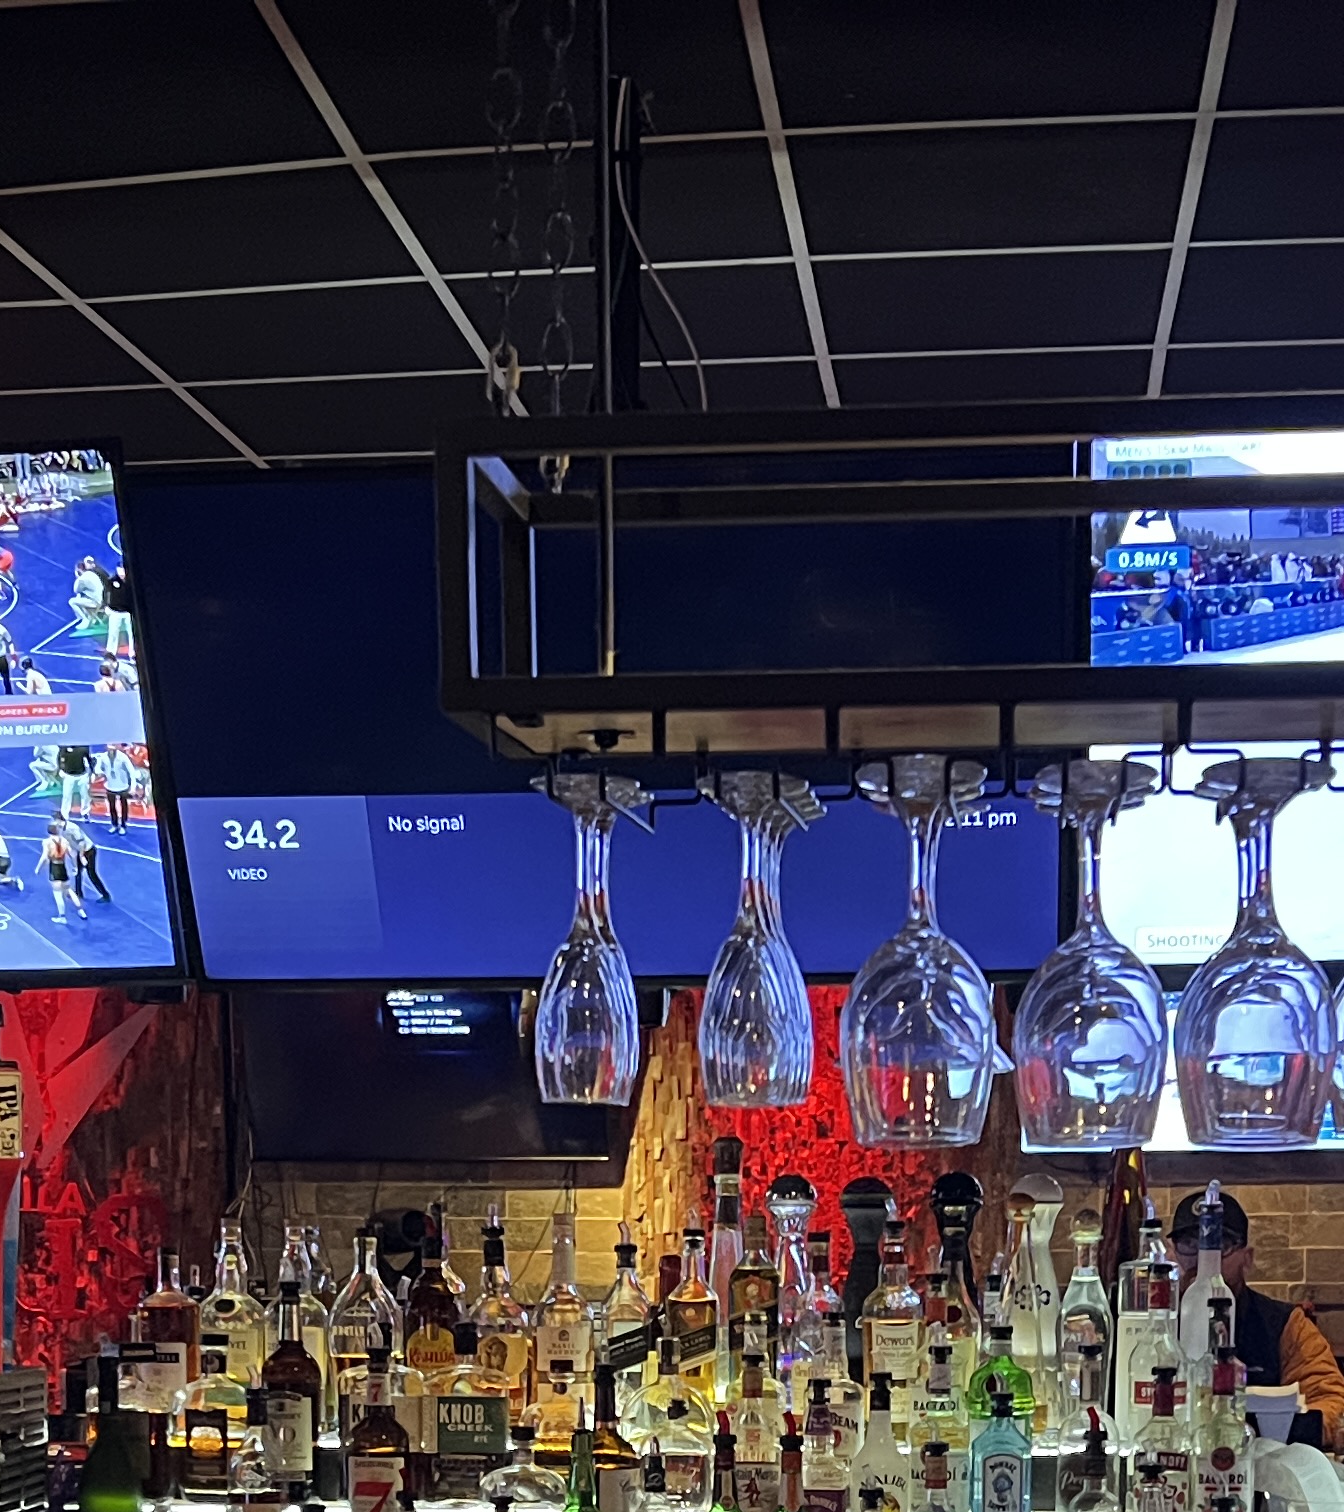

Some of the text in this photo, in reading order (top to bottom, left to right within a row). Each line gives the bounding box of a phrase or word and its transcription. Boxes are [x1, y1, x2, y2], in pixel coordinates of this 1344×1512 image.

[1118, 551, 1179, 568] 0.8M/S
[15, 722, 69, 736] BUREAU
[388, 814, 465, 834] No signal
[988, 812, 1017, 828] pm
[223, 819, 300, 850] 34.2
[228, 869, 268, 881] VIDEO
[370, 1383, 382, 1403] 7
[439, 1403, 485, 1424] KNOB
[447, 1423, 494, 1432] CREEK
[861, 1473, 906, 1491] ALIBU
[1198, 1473, 1248, 1485] BACRDI
